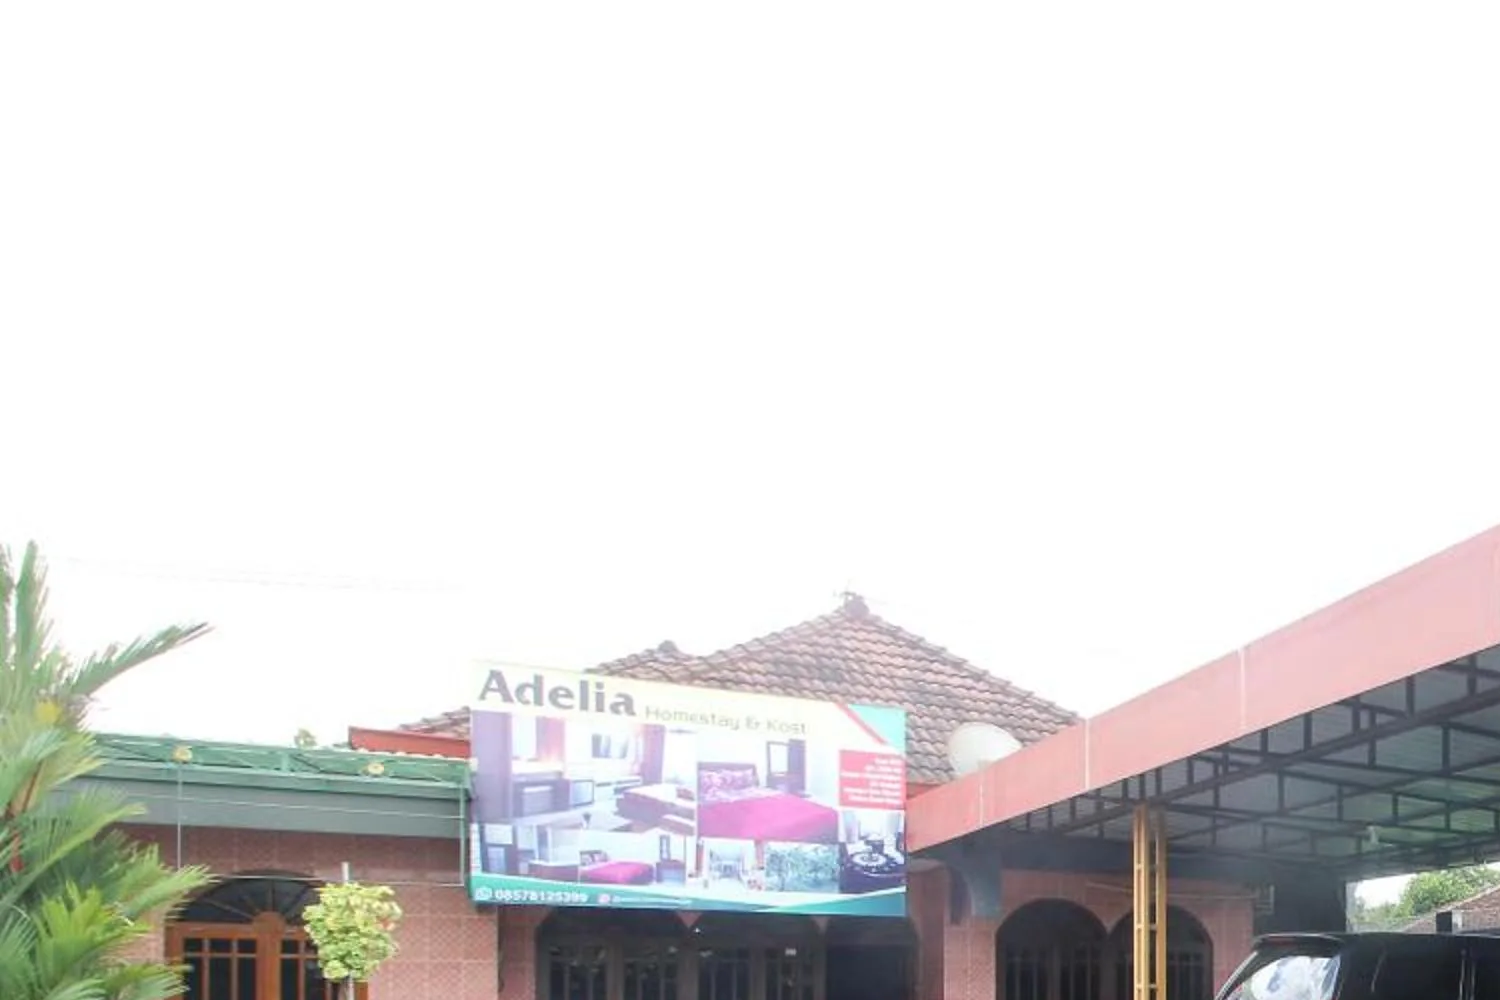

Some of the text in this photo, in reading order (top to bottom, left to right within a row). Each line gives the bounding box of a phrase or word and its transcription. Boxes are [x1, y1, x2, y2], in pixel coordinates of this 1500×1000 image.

[478, 669, 806, 735] Adelia Homestay & Kost
